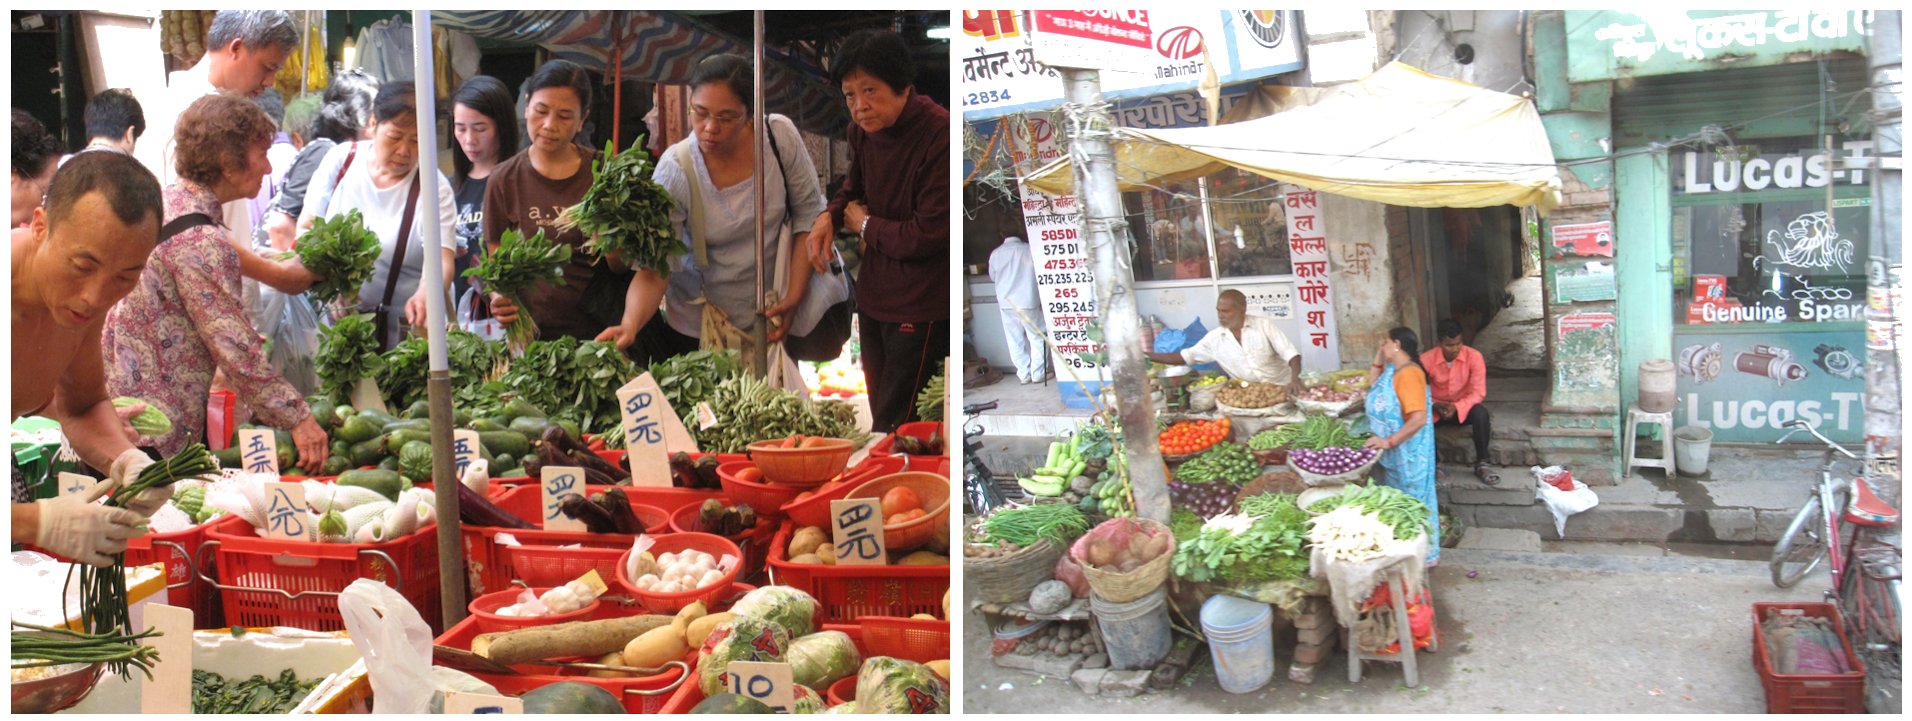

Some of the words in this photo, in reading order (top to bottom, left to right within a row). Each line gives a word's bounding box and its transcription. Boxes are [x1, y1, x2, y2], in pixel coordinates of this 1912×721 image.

[1054, 287, 1079, 299] 265
[1702, 301, 1787, 322] Genuine
[269, 488, 306, 536] 八元
